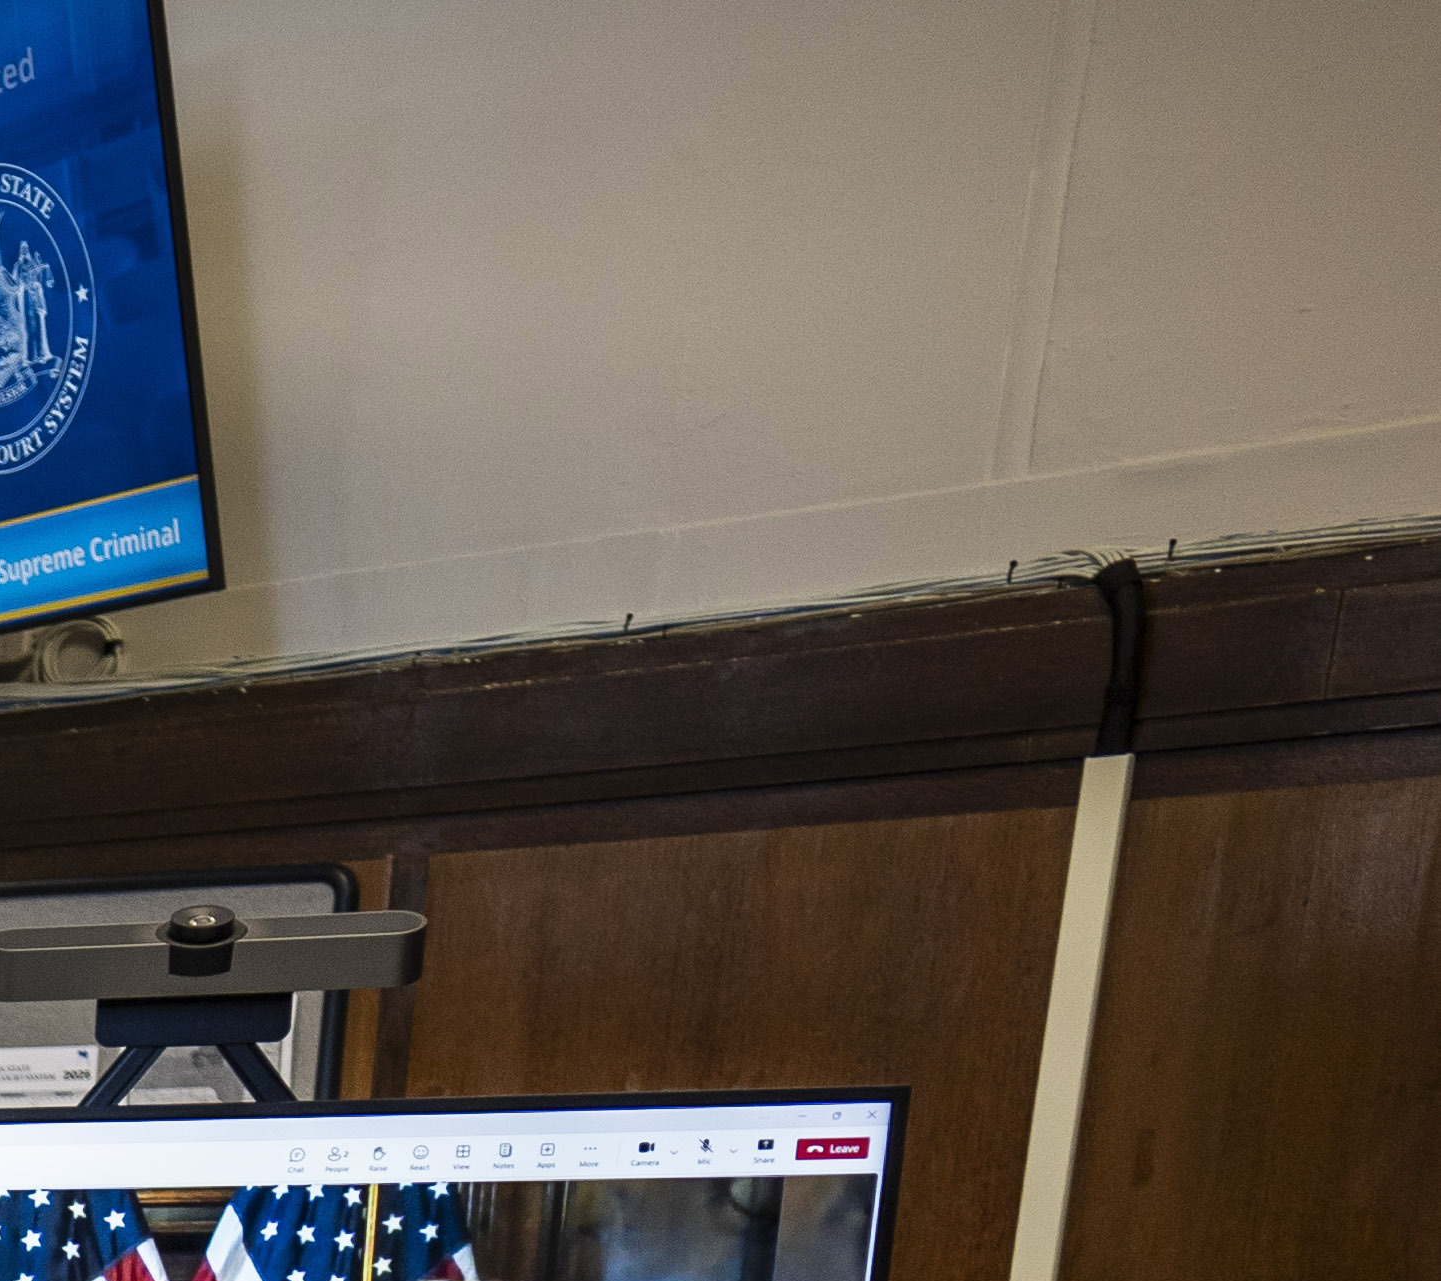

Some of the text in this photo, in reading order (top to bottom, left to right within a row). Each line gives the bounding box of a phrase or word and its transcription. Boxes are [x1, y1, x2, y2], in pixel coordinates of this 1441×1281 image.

[0, 172, 56, 219] STATE
[43, 335, 90, 435] SYSTEM
[89, 518, 181, 564] Criminal
[829, 1143, 860, 1154] Leave
[452, 1162, 470, 1170] View
[493, 1162, 515, 1170] Notes
[536, 1161, 556, 1170] Apps
[579, 1160, 599, 1168] More
[630, 1158, 660, 1167] Camera
[287, 1166, 304, 1174] Chat
[325, 1166, 350, 1174] People
[409, 1163, 430, 1171] React
